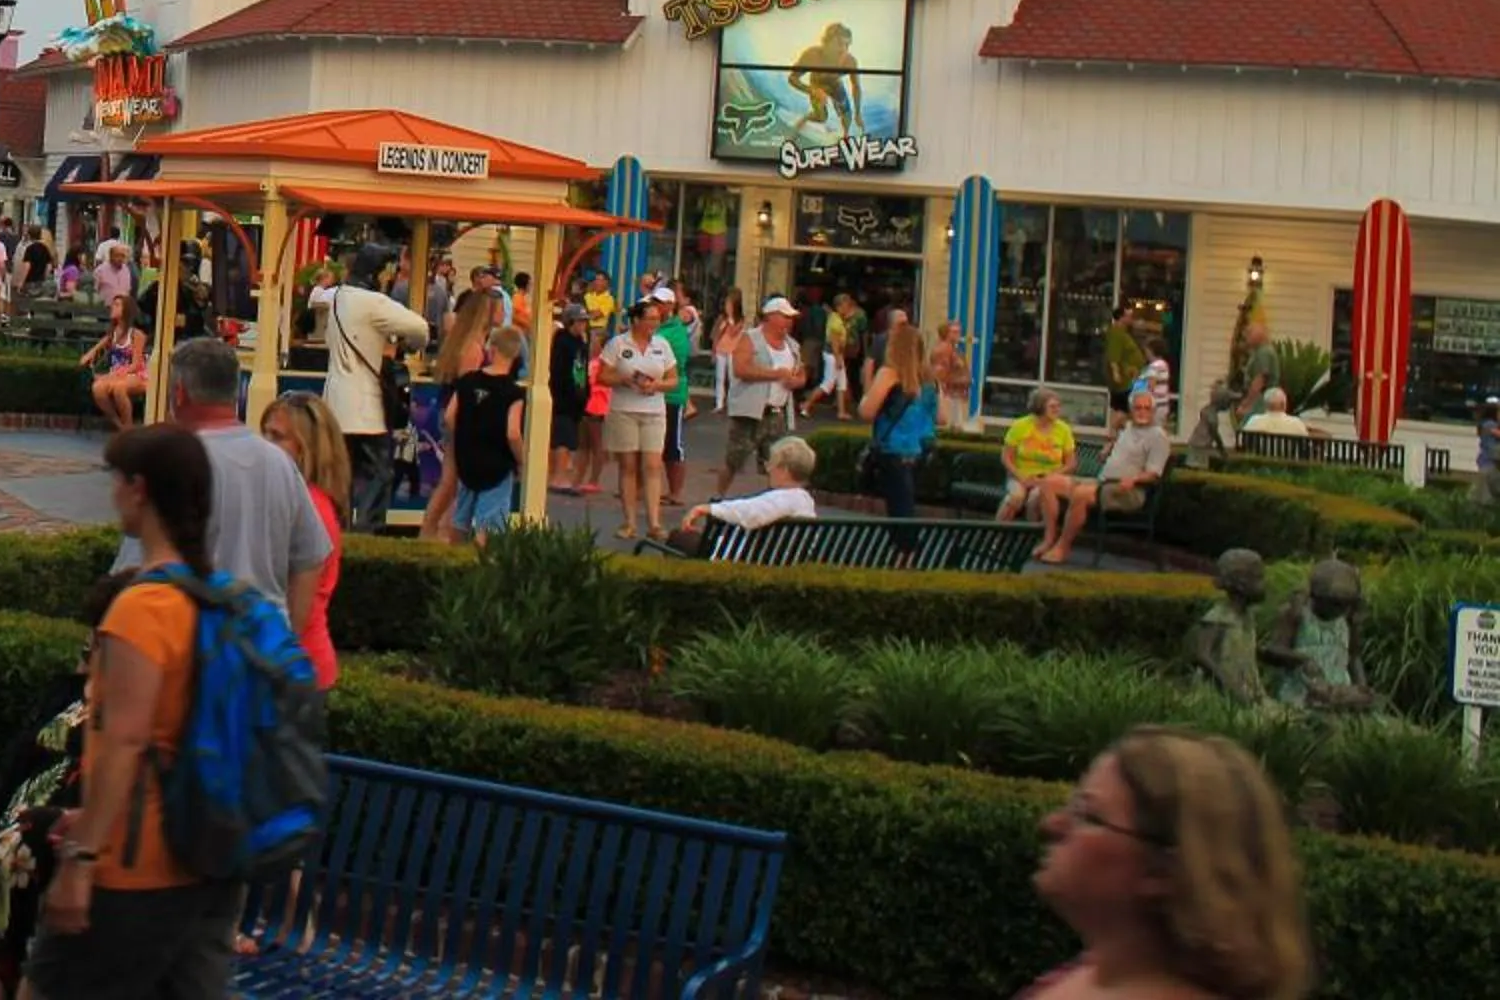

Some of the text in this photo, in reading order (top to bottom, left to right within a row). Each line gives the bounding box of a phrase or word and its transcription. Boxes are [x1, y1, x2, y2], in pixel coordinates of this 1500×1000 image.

[381, 145, 487, 174] LEGENDS IN CONCERT
[1474, 644, 1499, 657] YOU
